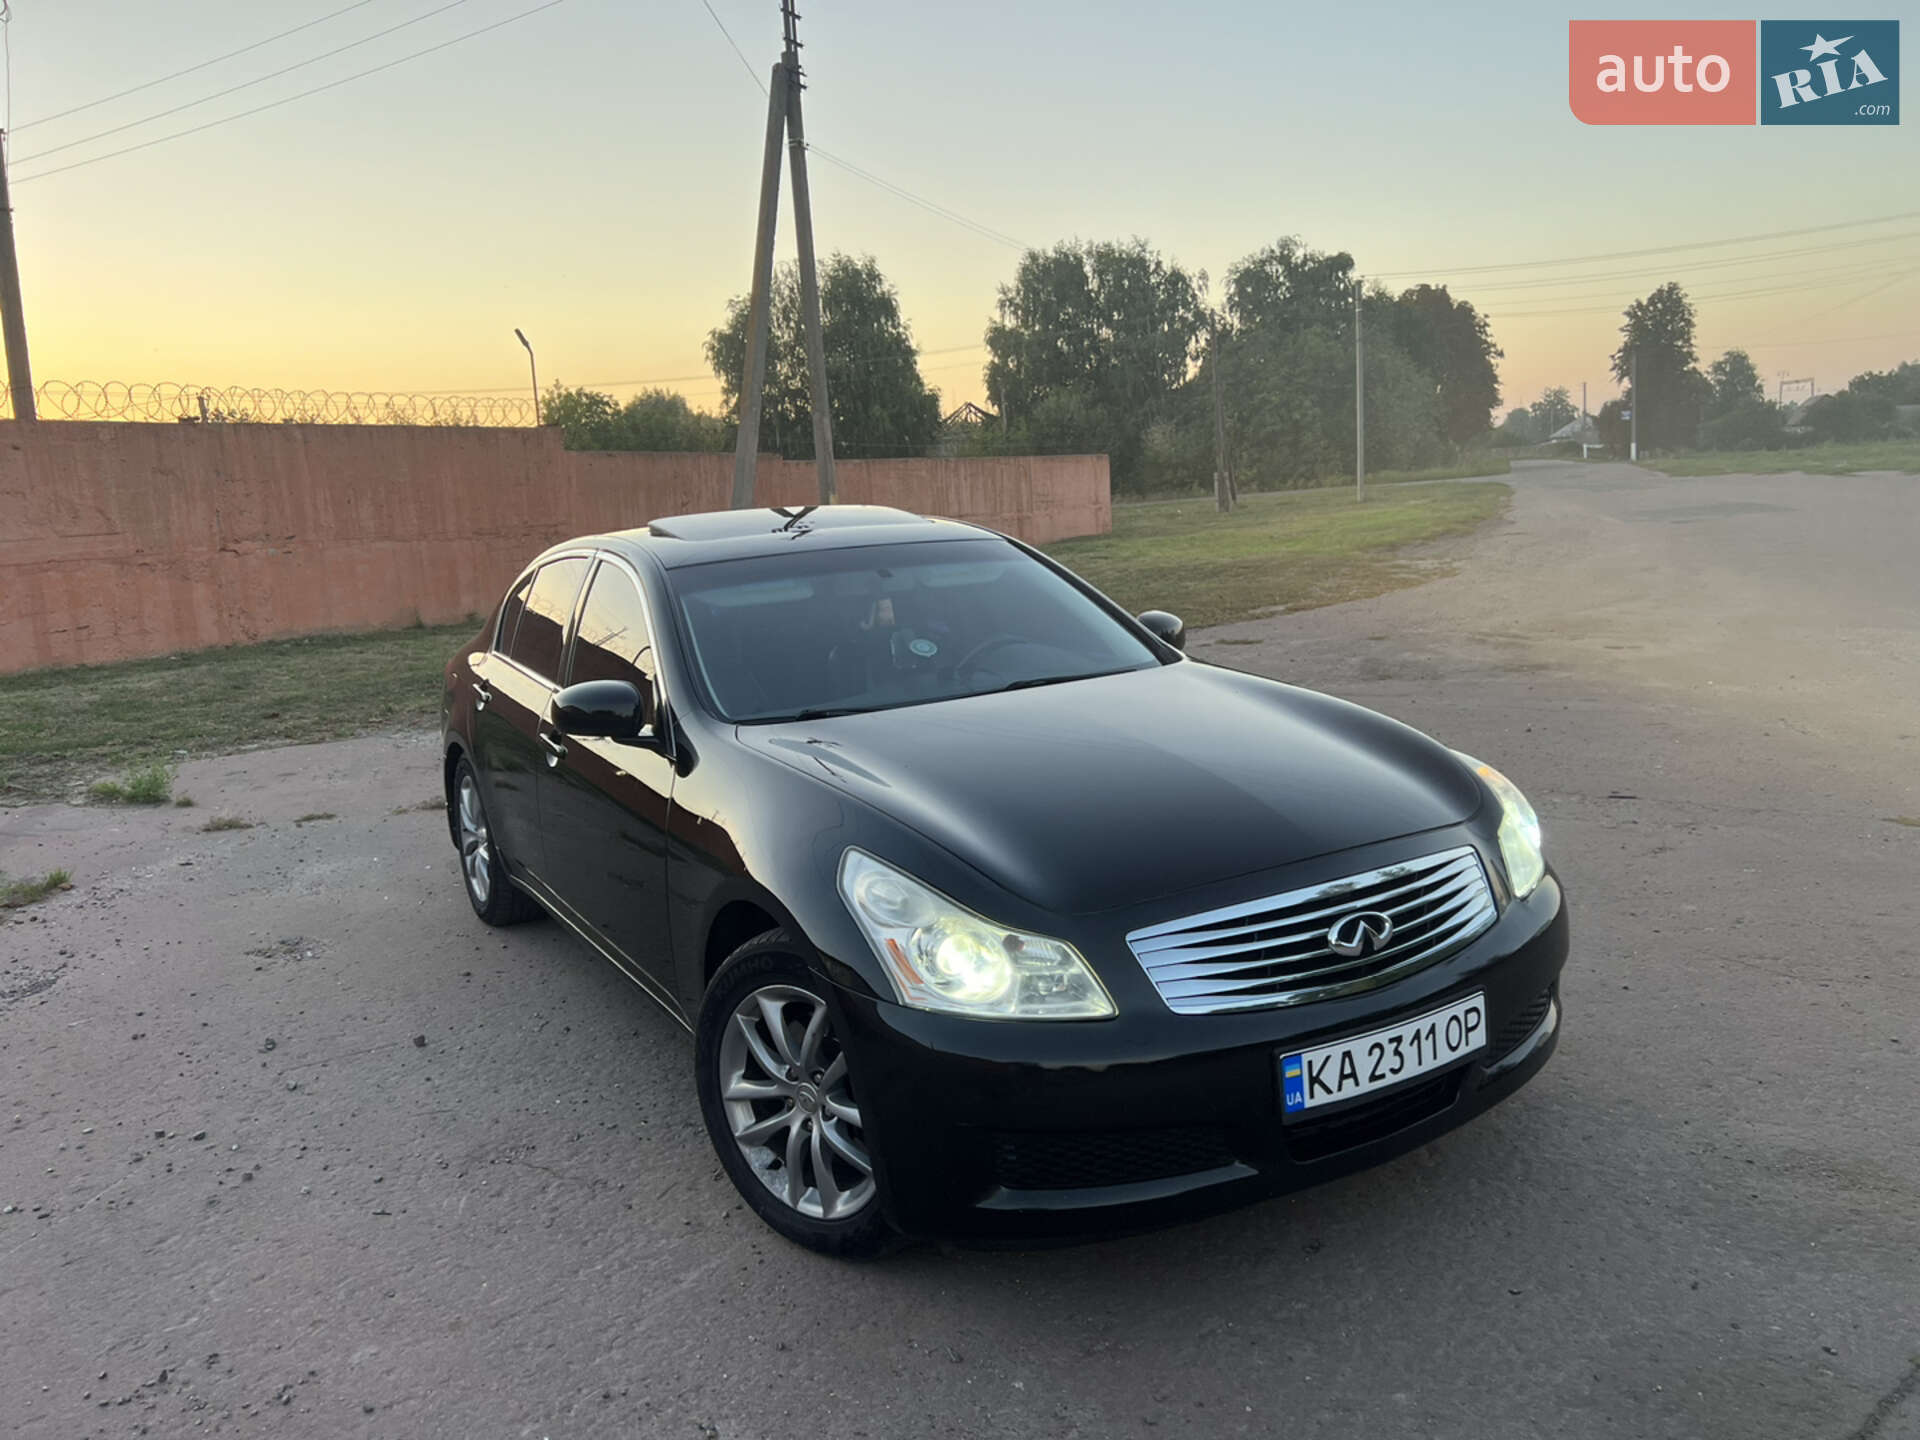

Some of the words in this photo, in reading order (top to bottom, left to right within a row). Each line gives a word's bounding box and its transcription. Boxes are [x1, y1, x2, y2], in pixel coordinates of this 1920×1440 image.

[1306, 1051, 1360, 1100] KA
[1367, 1022, 1438, 1084] 2311
[1445, 1006, 1481, 1053] OP
[1286, 1091, 1303, 1106] UA
